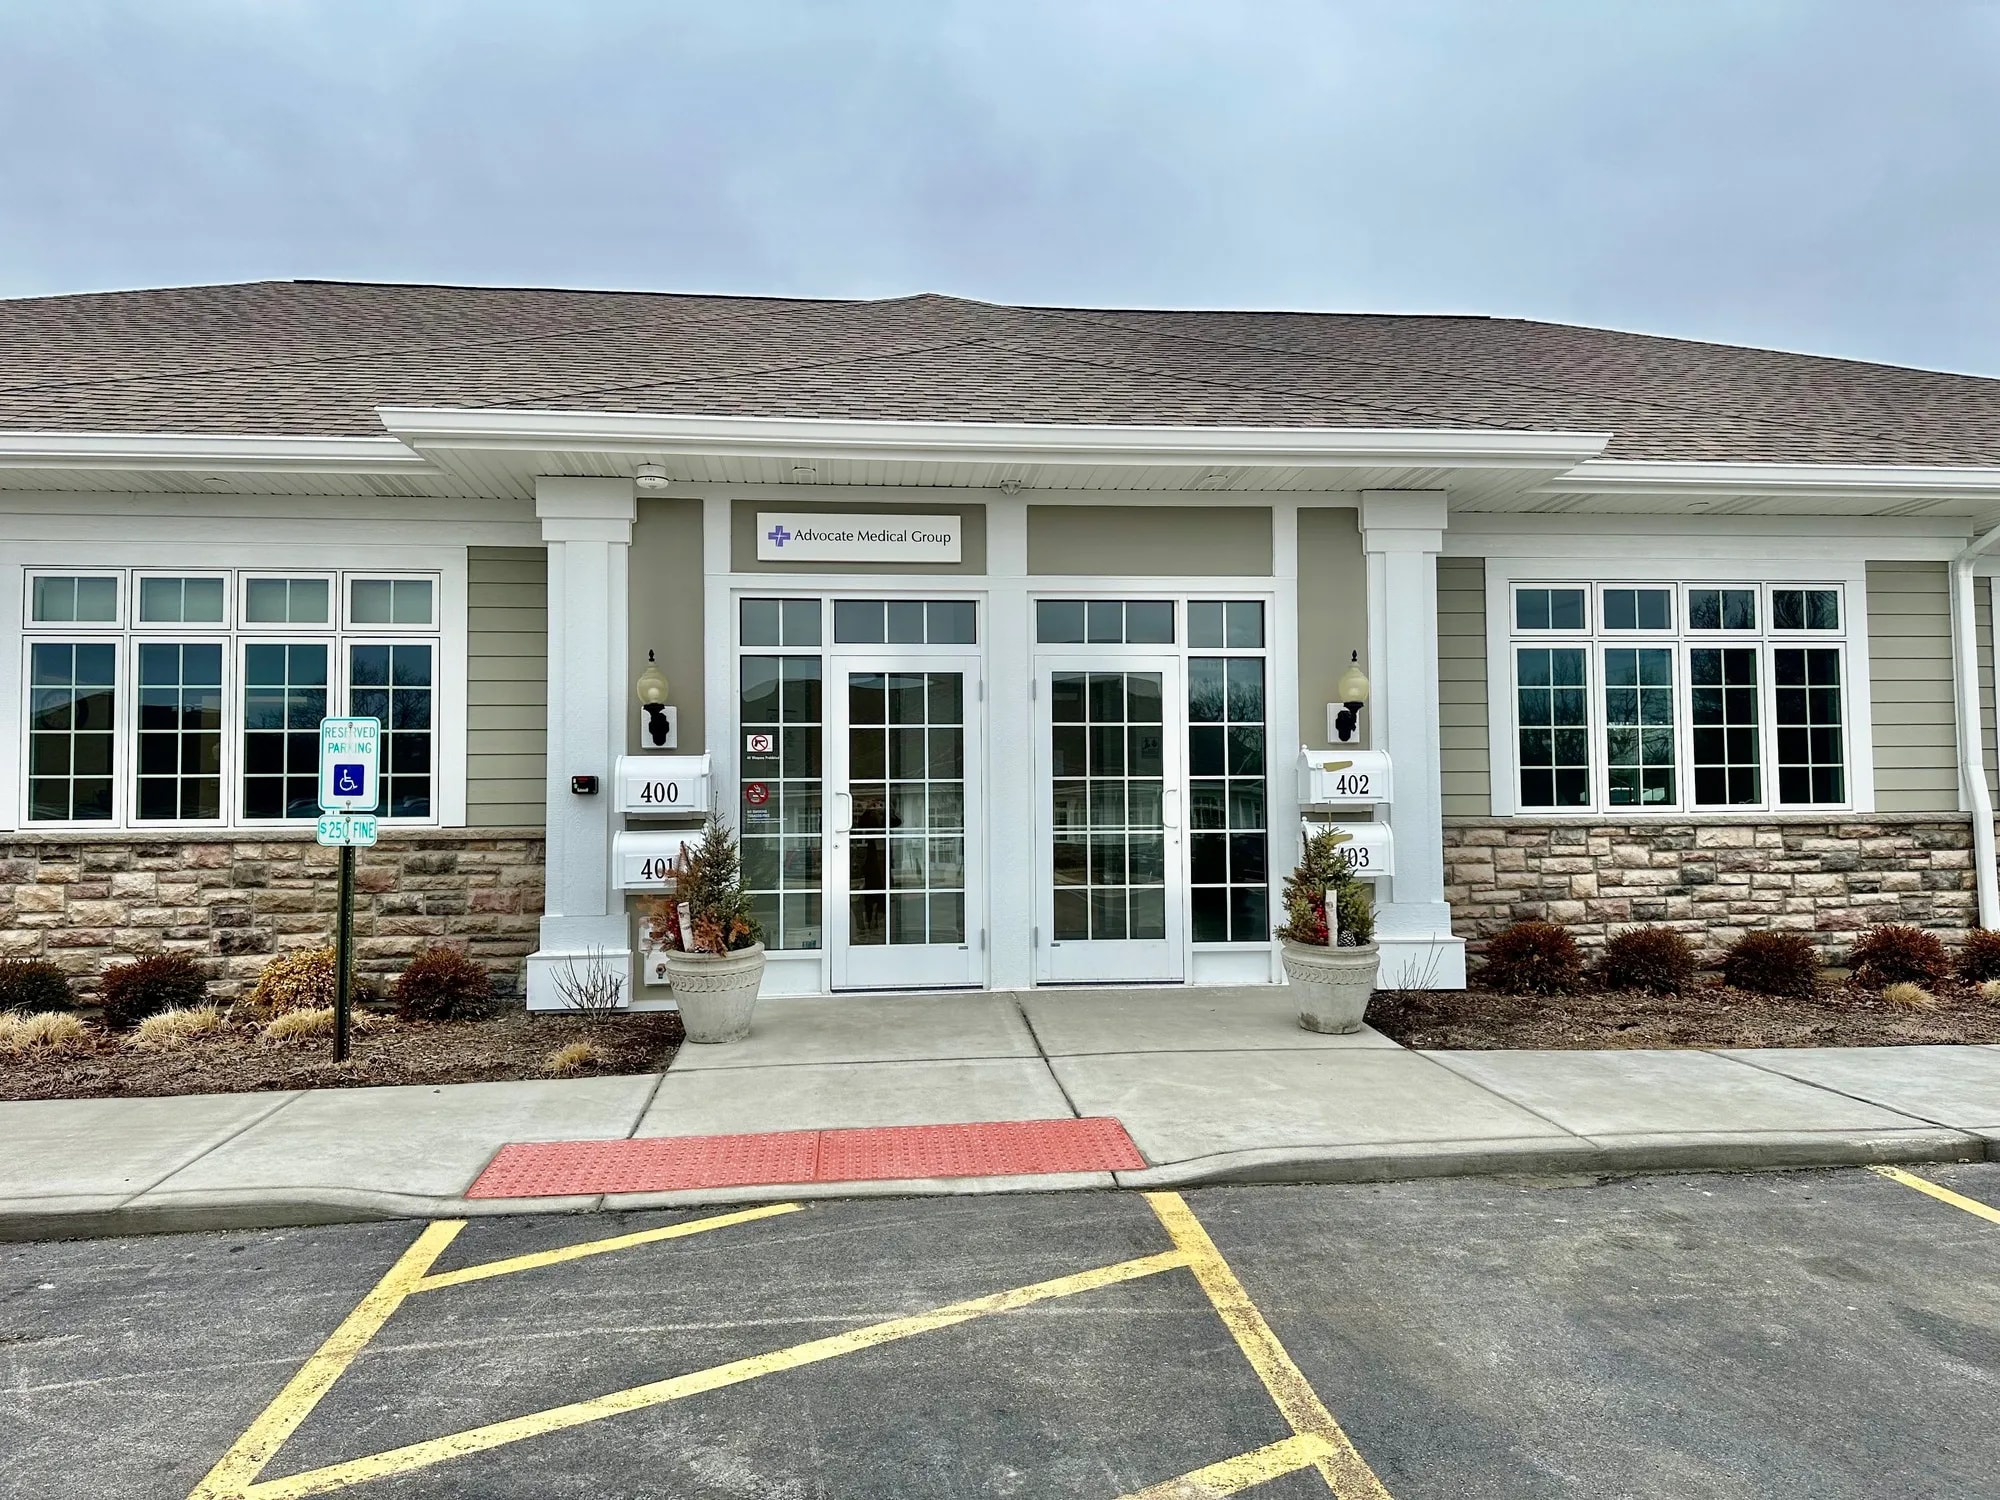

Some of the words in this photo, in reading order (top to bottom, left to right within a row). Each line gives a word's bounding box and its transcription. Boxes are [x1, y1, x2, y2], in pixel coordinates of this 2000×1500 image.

[794, 529, 854, 542] Advocate
[857, 529, 907, 543] Medical
[911, 530, 952, 546] Group
[328, 742, 372, 754] PARING
[640, 782, 679, 803] 400
[1336, 775, 1369, 795] 402
[353, 821, 374, 839] FINE
[1339, 847, 1370, 868] 03
